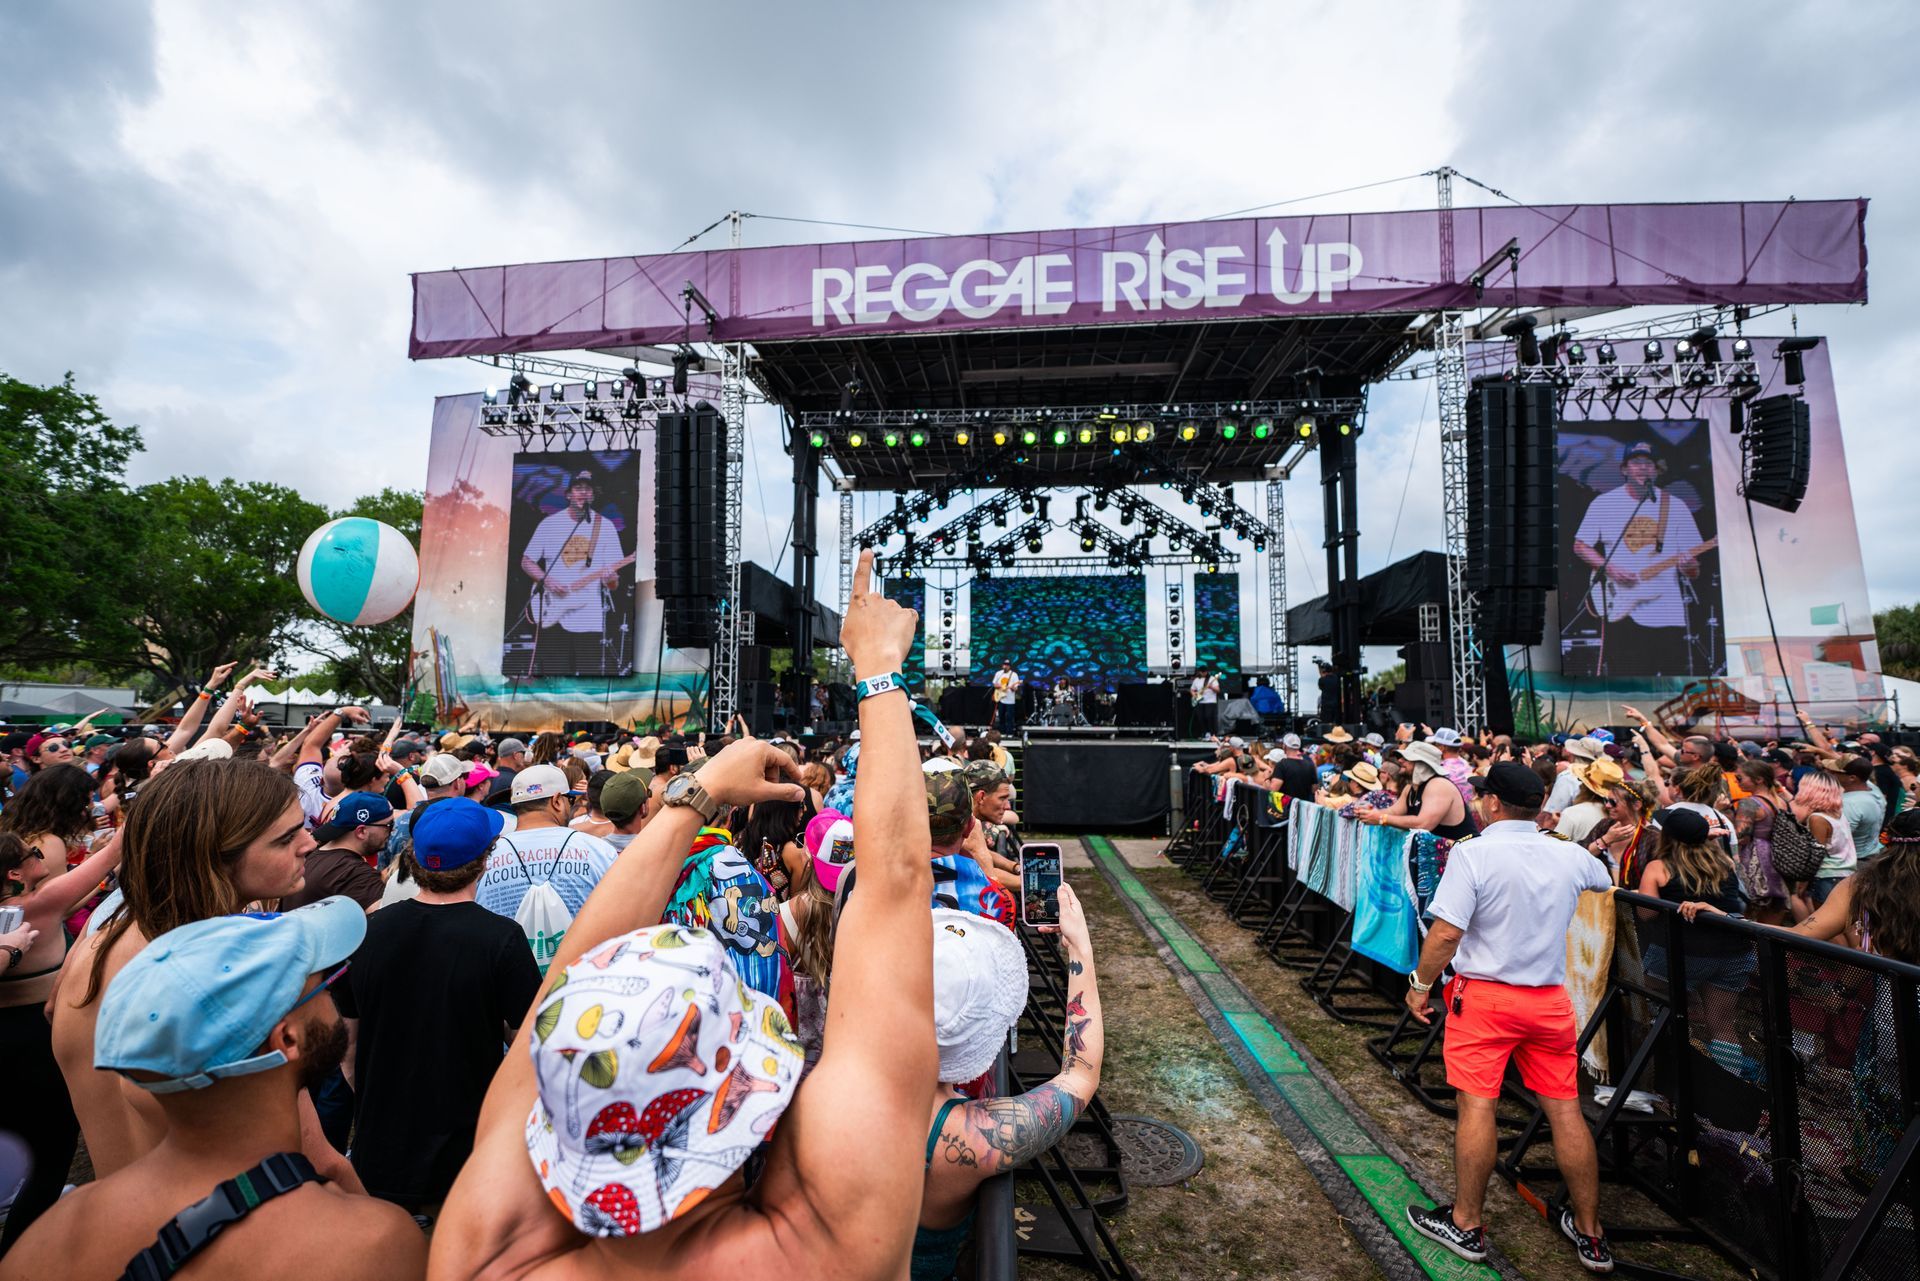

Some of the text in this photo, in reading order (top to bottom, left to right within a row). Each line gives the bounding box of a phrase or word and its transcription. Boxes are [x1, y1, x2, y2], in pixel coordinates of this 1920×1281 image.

[812, 227, 1363, 326] REGGAE RISE UP
[872, 680, 890, 691] GA
[485, 848, 590, 871] ERIC RACHMANY
[484, 861, 590, 887] ACOUSTIC TOUR
